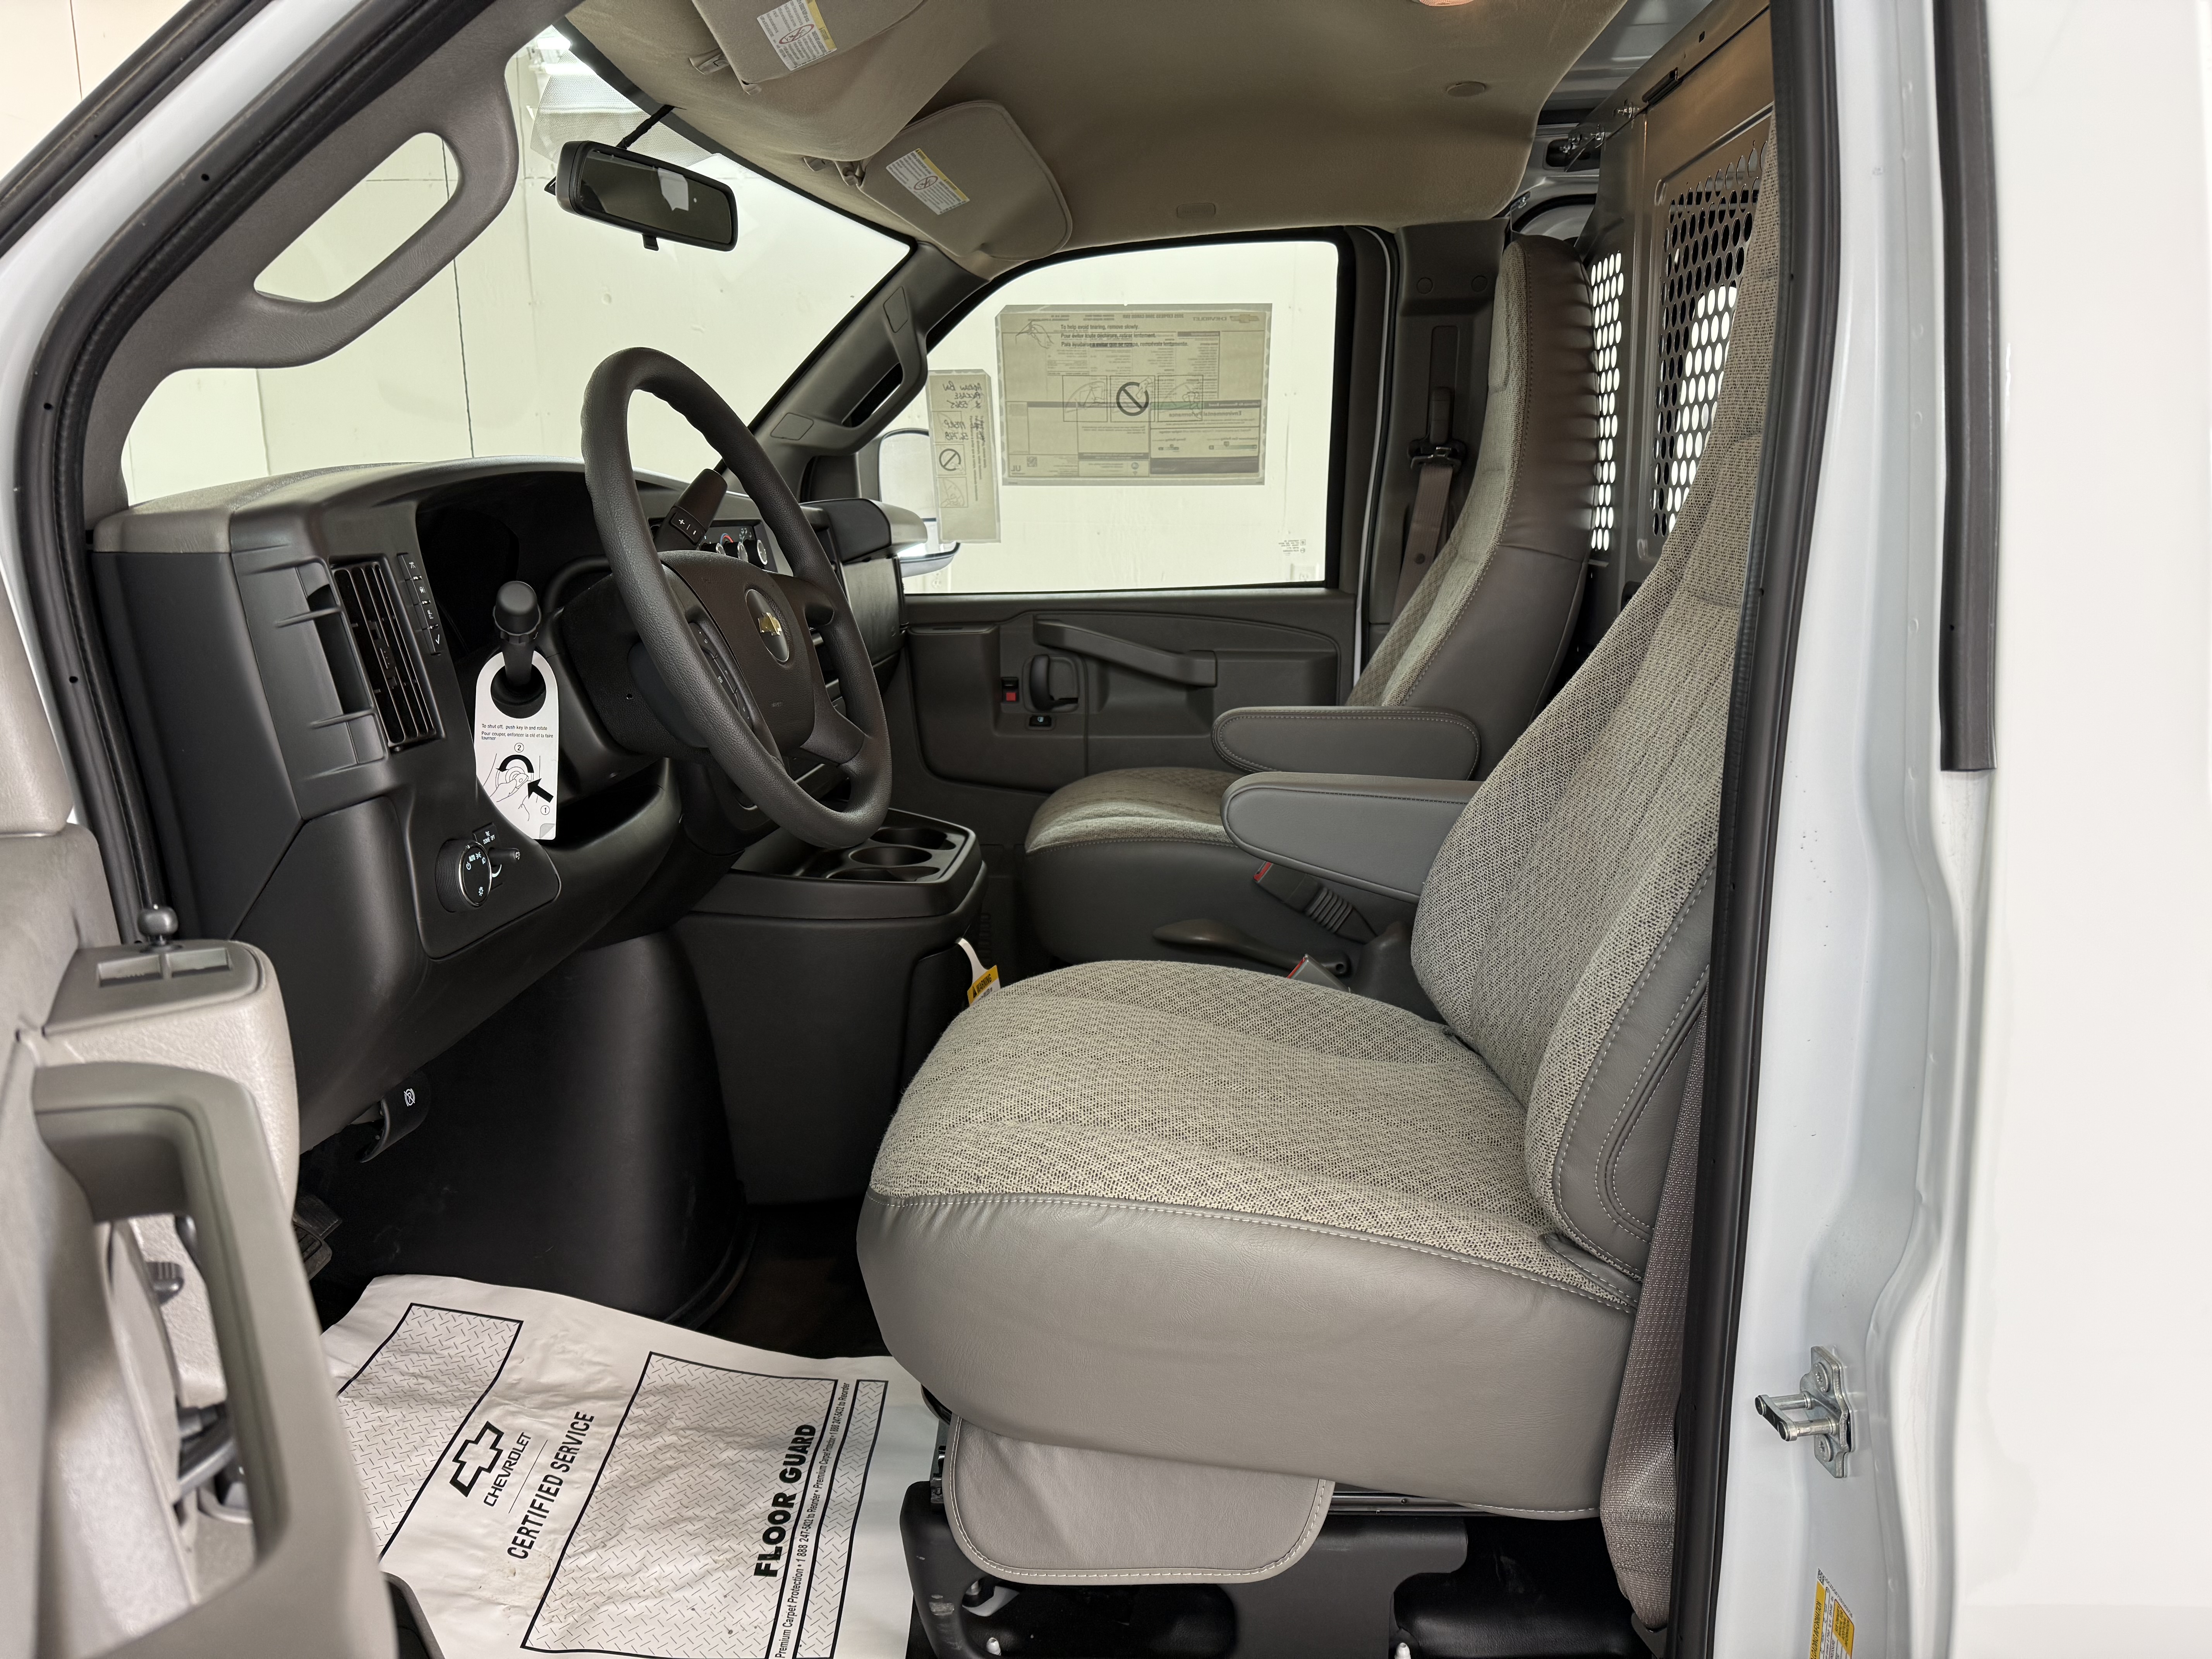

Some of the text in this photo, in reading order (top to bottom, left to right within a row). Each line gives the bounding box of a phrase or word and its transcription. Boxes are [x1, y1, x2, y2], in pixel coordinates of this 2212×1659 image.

[976, 974, 992, 993] WARNING
[838, 1382, 850, 1401] Reorder
[832, 1406, 845, 1424] 247-5432
[819, 1449, 832, 1465] Carpet
[484, 1432, 531, 1507] CHEVROLET
[813, 1465, 827, 1489] Premium
[507, 1411, 594, 1559] CERTIFIED SERVICE
[754, 1424, 816, 1577] FLOOR GUARD
[811, 1493, 821, 1509] Reorder
[807, 1510, 815, 1518] to
[800, 1516, 813, 1542] 247-5432
[797, 1544, 807, 1557] 888
[788, 1569, 804, 1603] Protection
[783, 1604, 797, 1628] Carpet
[1813, 1599, 1822, 1636] INFORMATION
[775, 1629, 791, 1659] Premium
